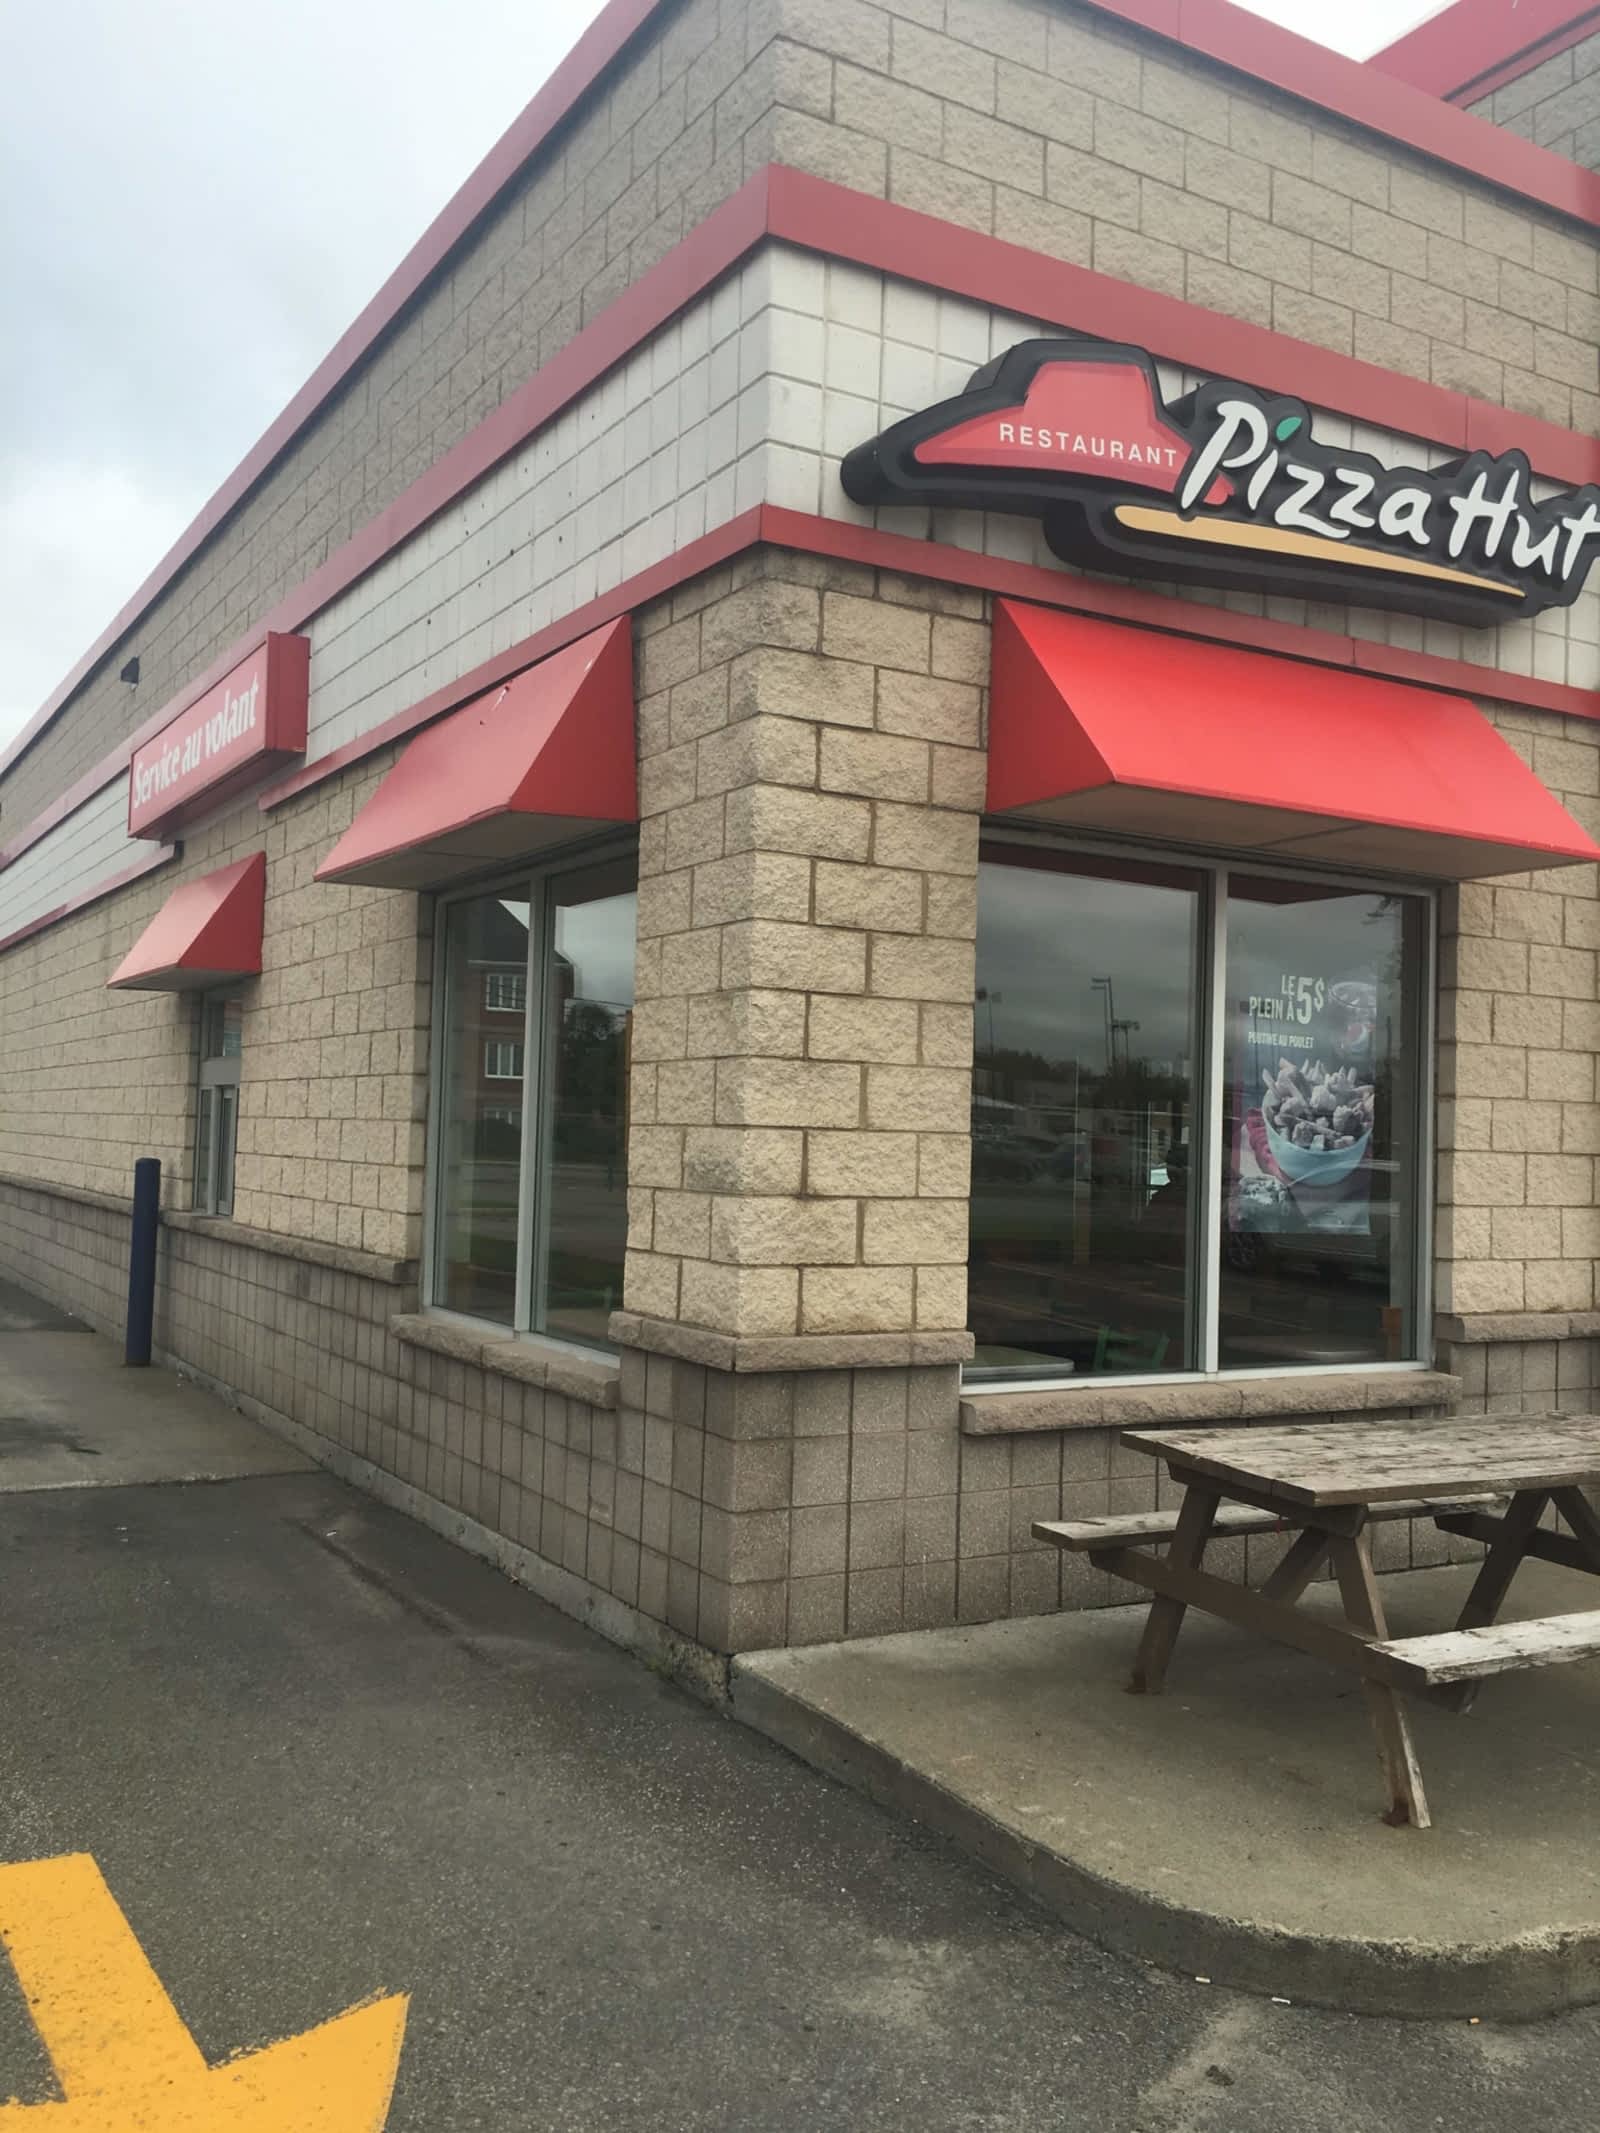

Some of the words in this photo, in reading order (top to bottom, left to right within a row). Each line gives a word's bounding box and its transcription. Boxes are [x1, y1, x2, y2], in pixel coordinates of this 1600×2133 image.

[1000, 423, 1177, 467] RESTAURANT
[1181, 400, 1431, 546] Pizza
[1449, 469, 1600, 581] Hut
[134, 743, 179, 808] Service
[181, 727, 203, 775] au
[205, 672, 259, 759] volant
[1281, 974, 1296, 995] LE
[1248, 996, 1283, 1019] PLEIN
